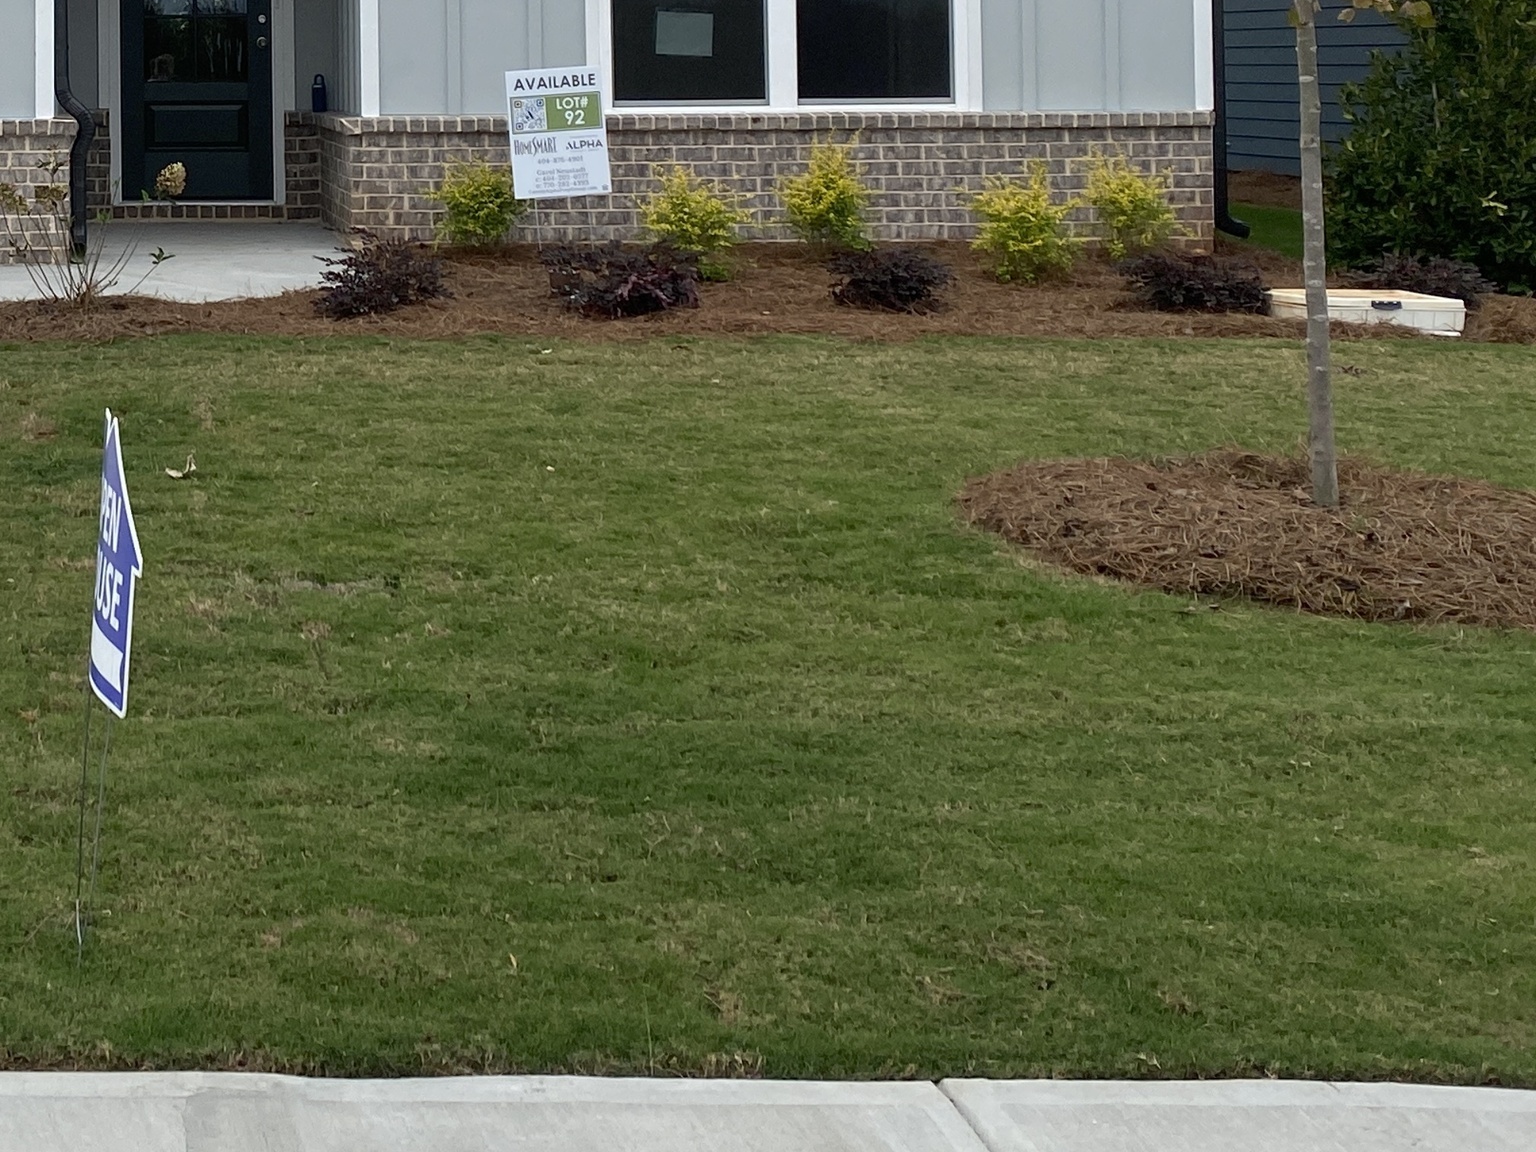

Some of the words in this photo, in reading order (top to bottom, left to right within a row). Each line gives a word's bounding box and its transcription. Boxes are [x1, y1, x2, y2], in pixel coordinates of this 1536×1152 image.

[514, 73, 596, 92] AVAILABLE
[556, 96, 589, 110] LOT#
[564, 110, 586, 126] 92
[565, 139, 603, 150] ALPHA
[100, 477, 122, 553] PEN
[95, 544, 124, 632] USE
